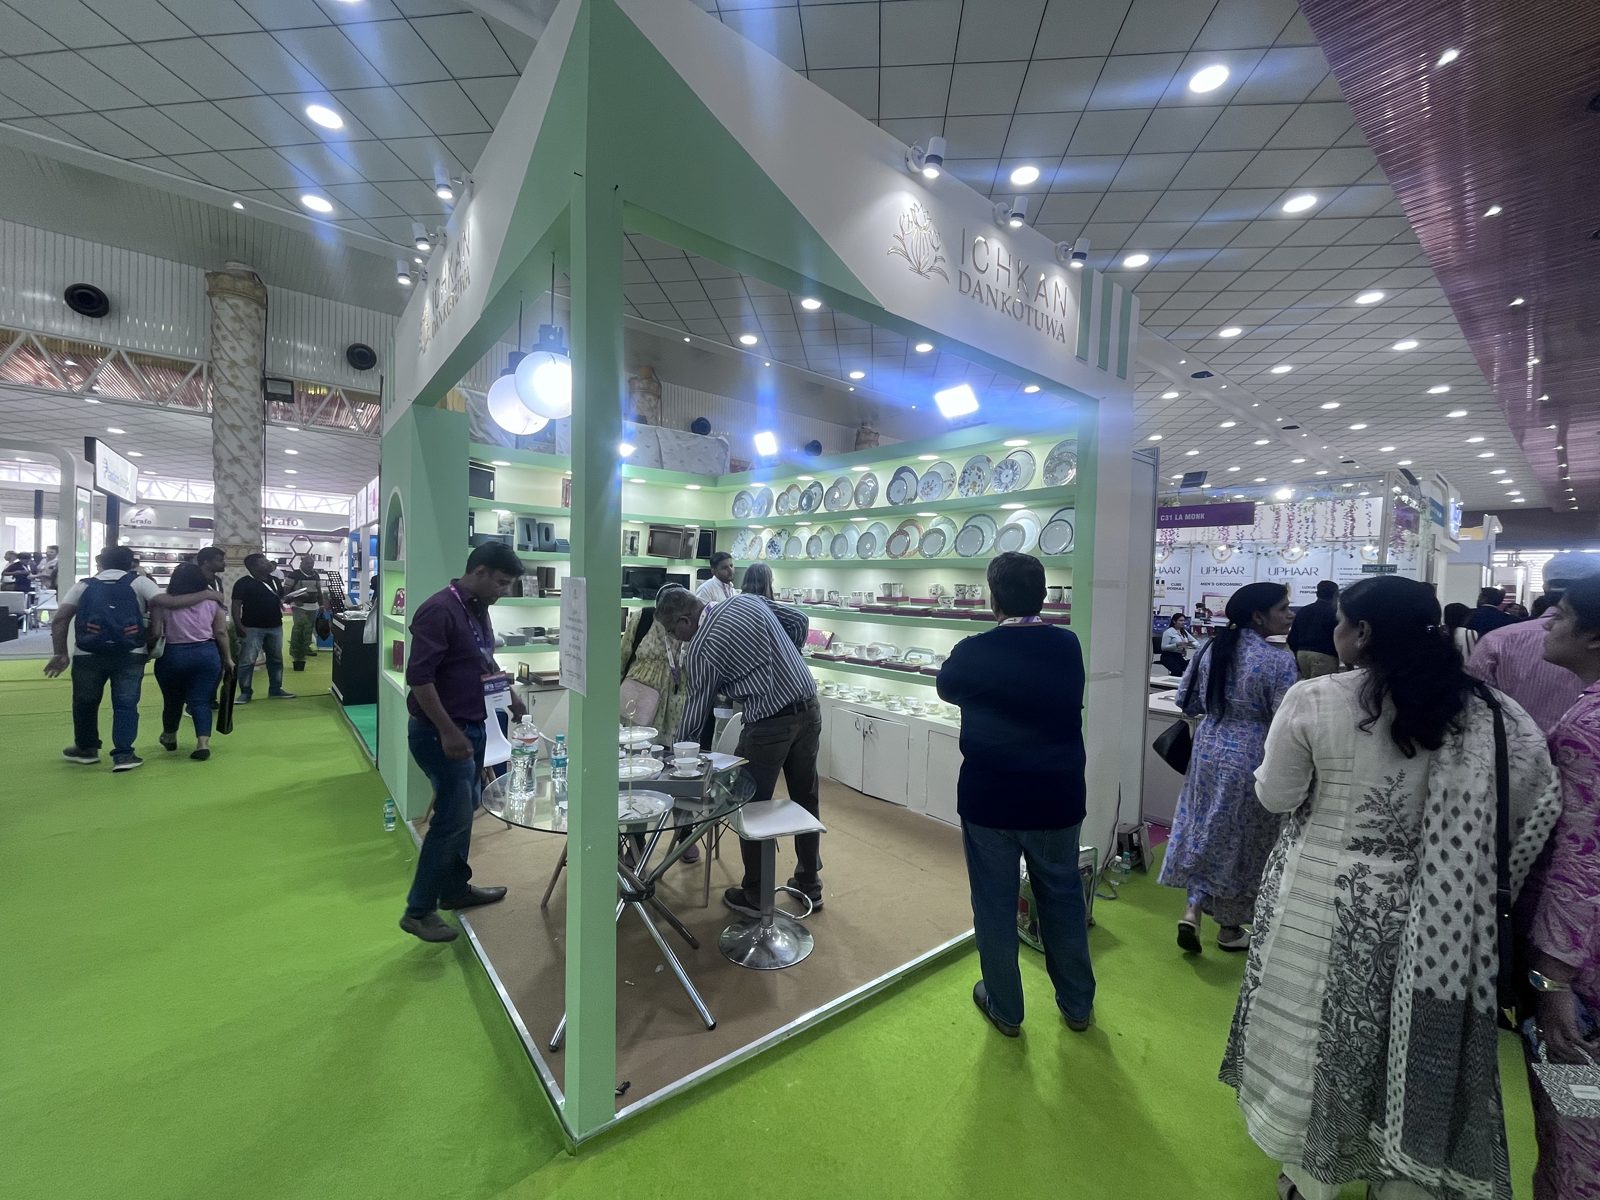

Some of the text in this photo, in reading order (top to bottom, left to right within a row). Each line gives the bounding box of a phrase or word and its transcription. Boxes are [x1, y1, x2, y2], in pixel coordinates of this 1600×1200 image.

[960, 227, 1068, 319] ICHKAN
[958, 269, 1066, 345] DANKOTUWA
[1160, 514, 1173, 522] C31
[1184, 512, 1206, 520] MONK
[1155, 566, 1181, 575] HAAR
[1200, 566, 1245, 575] UPHAAR
[1268, 566, 1319, 576] UPHAAR
